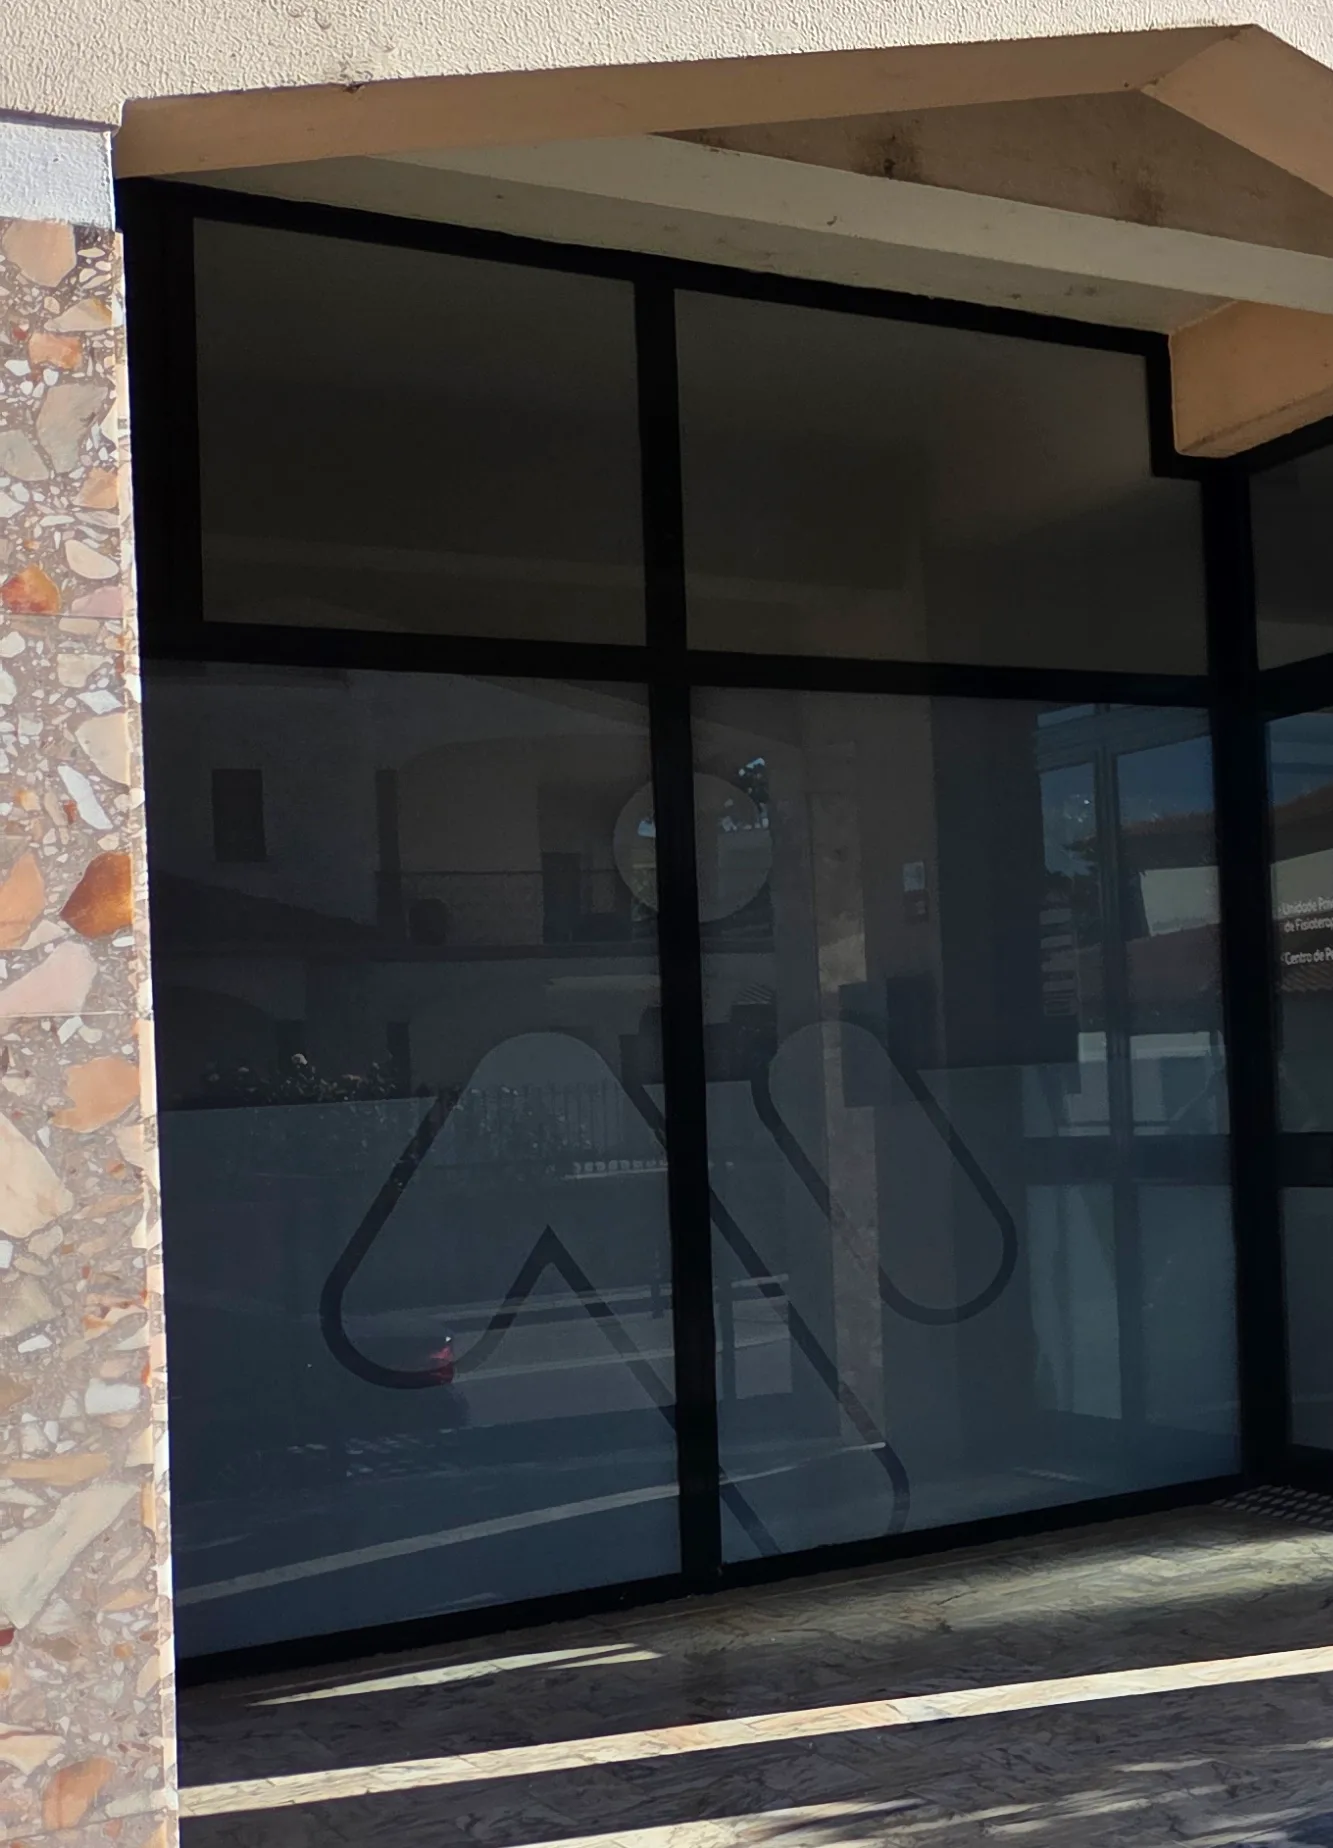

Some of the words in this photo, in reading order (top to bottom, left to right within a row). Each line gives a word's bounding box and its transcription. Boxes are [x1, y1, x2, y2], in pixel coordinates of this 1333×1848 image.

[1283, 899, 1318, 915] Unidade
[1284, 921, 1295, 933] de
[1284, 950, 1312, 966] Centro
[1313, 948, 1325, 962] de
